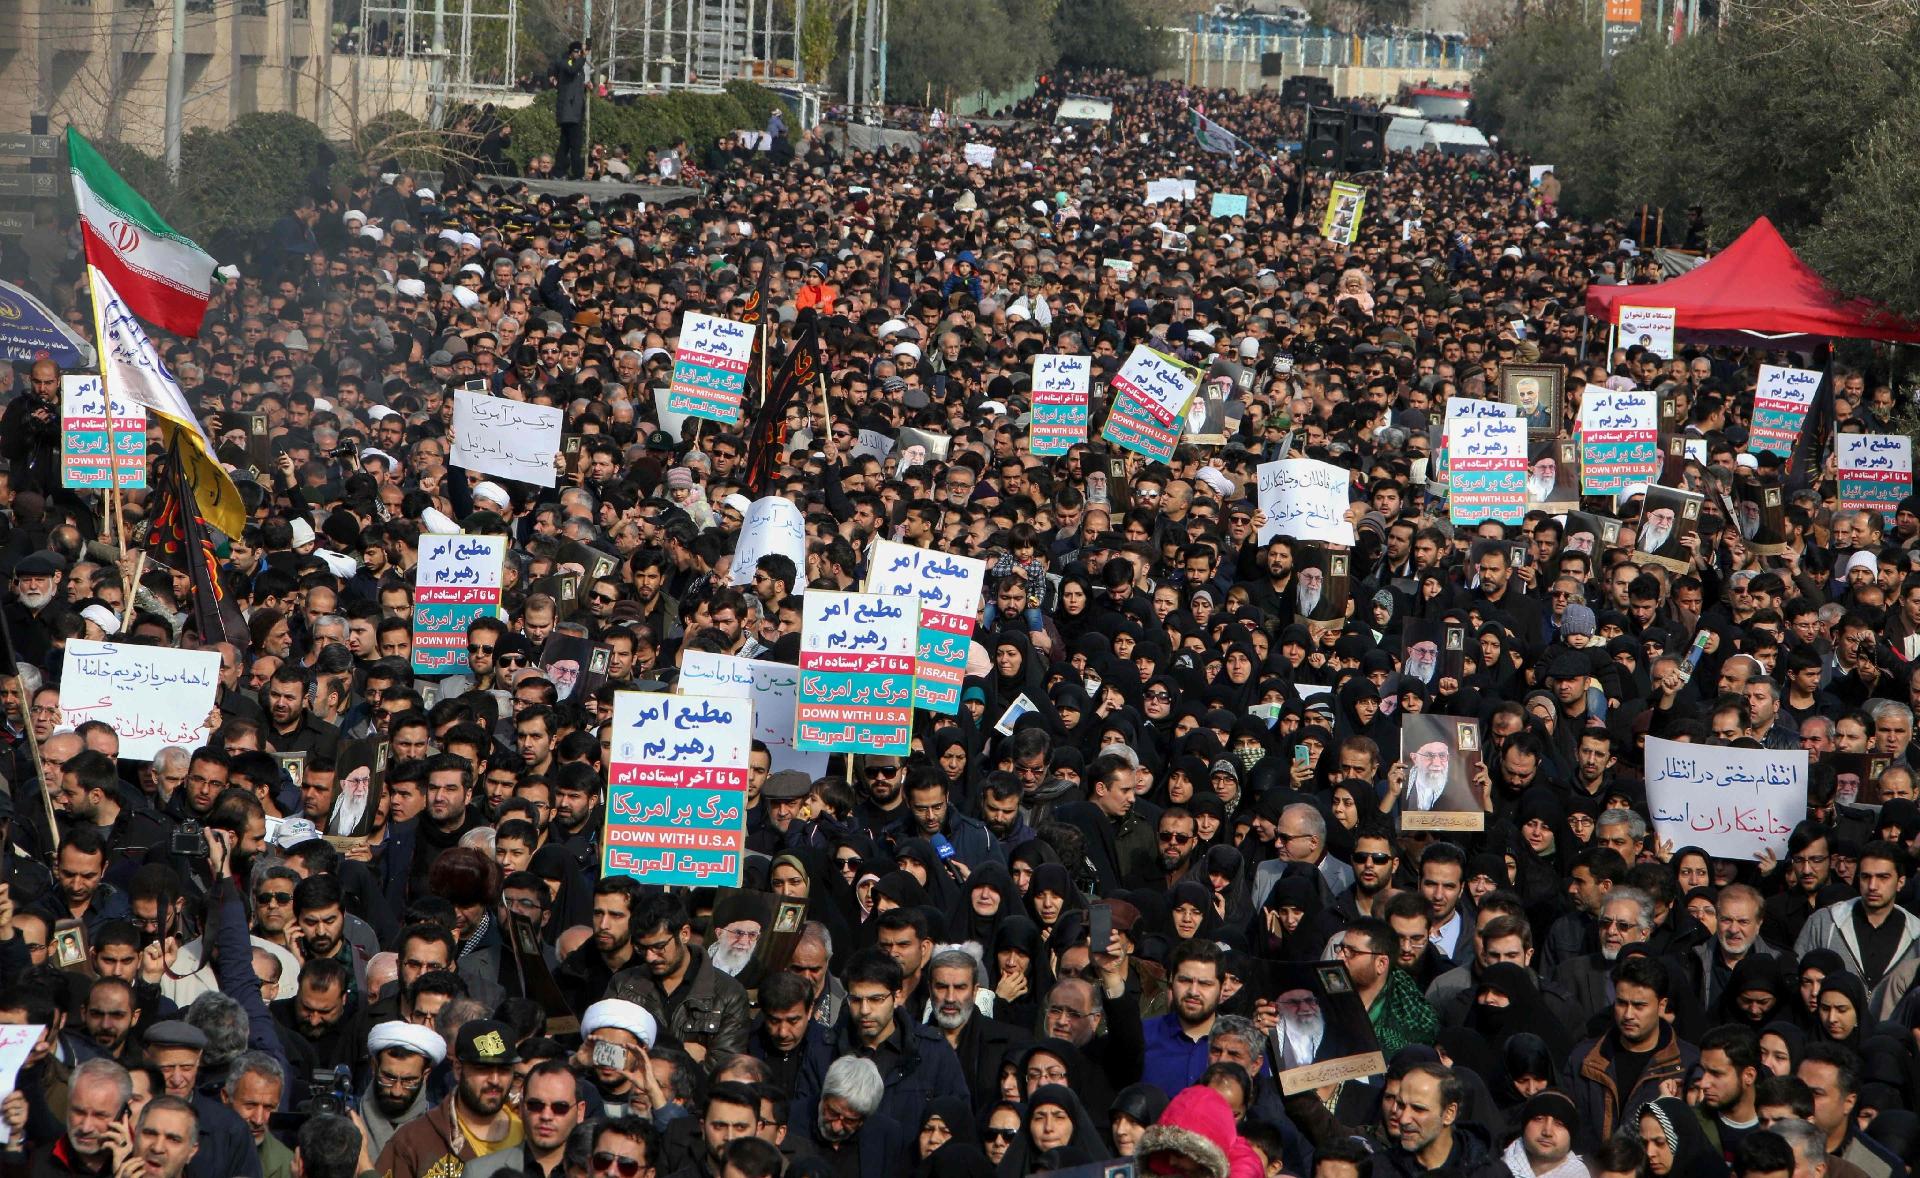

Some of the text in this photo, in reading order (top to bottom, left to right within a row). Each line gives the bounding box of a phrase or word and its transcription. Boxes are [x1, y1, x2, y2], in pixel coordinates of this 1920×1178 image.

[1652, 312, 1672, 320] دستگاه
[691, 319, 744, 338] مطیع امر
[1652, 323, 1671, 331] موجود
[28, 338, 50, 350] پرداخت
[695, 339, 732, 356] رهبریم
[1041, 357, 1082, 373] مطیع امر
[676, 367, 742, 390] مرگ اسرائیل
[1046, 377, 1075, 390] رهبریم
[1138, 359, 1184, 391] مطیع امر
[1768, 370, 1815, 384] مطیع امر
[75, 379, 97, 396] امر
[673, 385, 738, 402] DOWN WITH ISRAEL
[1134, 374, 1167, 402] رهبریم
[1771, 388, 1804, 401] رهبریم
[671, 396, 736, 417] الموت لاسرائیل
[1456, 402, 1475, 416] امر
[1592, 394, 1646, 411] مطیع امر
[1112, 413, 1173, 443] DOWN WITH U.S.A
[1461, 420, 1516, 437] مطیع امر
[1600, 414, 1638, 428] رهبریم
[67, 434, 143, 453] مرگ امریکا
[1107, 424, 1170, 456] الموت لامریکا
[1468, 442, 1507, 455] رهبریم
[1848, 436, 1901, 452] مطیع امر
[1585, 445, 1653, 463] مرگ امریکا
[1854, 456, 1893, 468] رهبریم
[68, 468, 106, 484] لامریکا
[1453, 473, 1523, 491] مرگ امریکا
[1586, 476, 1621, 490] لامریکا
[1842, 484, 1877, 498] اسرائیل
[1306, 503, 1329, 528] تلخ
[1454, 506, 1524, 519] الموت لامریکا
[429, 539, 491, 560] مطیع امر
[888, 551, 969, 579] مطیع امر
[435, 565, 480, 584] رهبریم
[420, 589, 478, 602] آخر ایستاده ایم
[417, 608, 466, 631] بر امریکا
[819, 598, 902, 623] مطیع امر
[926, 614, 947, 627] آخر
[416, 636, 466, 645] DOWN WITH
[828, 630, 888, 650] رهبریم
[415, 650, 455, 668] لامریکا
[917, 640, 965, 662] مرگ بر
[807, 656, 909, 671] ما تا آخر ایستاده ایم
[922, 666, 960, 681] ISRAEL
[803, 676, 908, 705] مرگ بر امریکا
[915, 685, 957, 704] الموت
[632, 699, 669, 727] امر
[674, 700, 733, 730] مطیع
[802, 709, 906, 722] DOWN WITH U.S.A
[801, 724, 855, 745] لامریکا
[858, 728, 906, 748] الموت
[643, 737, 714, 762] رهبریم
[618, 768, 740, 789] ما تا آخر ایستاده ایم
[1756, 763, 1796, 795] انتقام
[613, 792, 738, 825] مرگ بر امریکا
[1653, 802, 1689, 822] است
[611, 831, 736, 847] DOWN WITH U.S.A
[609, 849, 736, 878] الموت لامریکا
